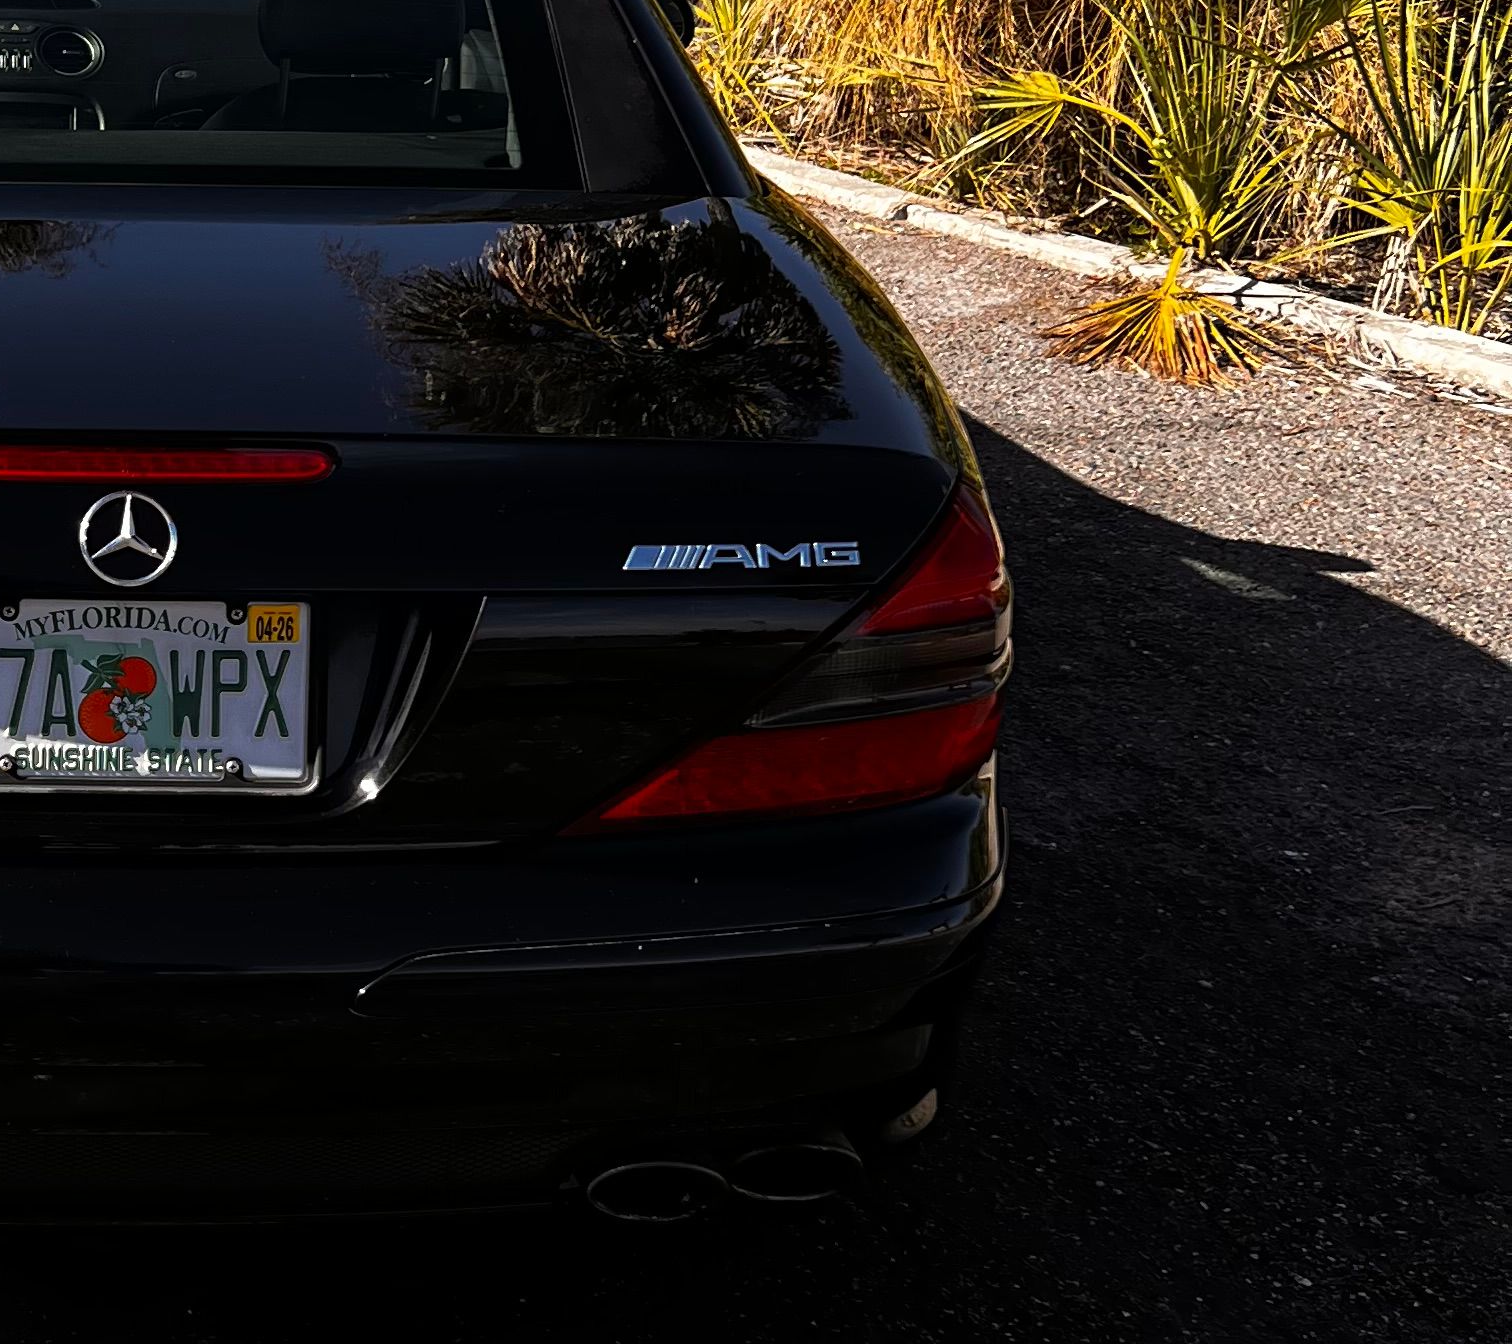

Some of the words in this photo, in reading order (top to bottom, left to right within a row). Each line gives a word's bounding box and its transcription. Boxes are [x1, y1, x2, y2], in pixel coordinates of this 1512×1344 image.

[698, 541, 861, 569] AMG
[12, 605, 230, 644] MYFLORIDA.COM
[169, 649, 291, 738] WPX
[13, 746, 133, 774] SUNSHINE
[145, 747, 224, 774] STATE
